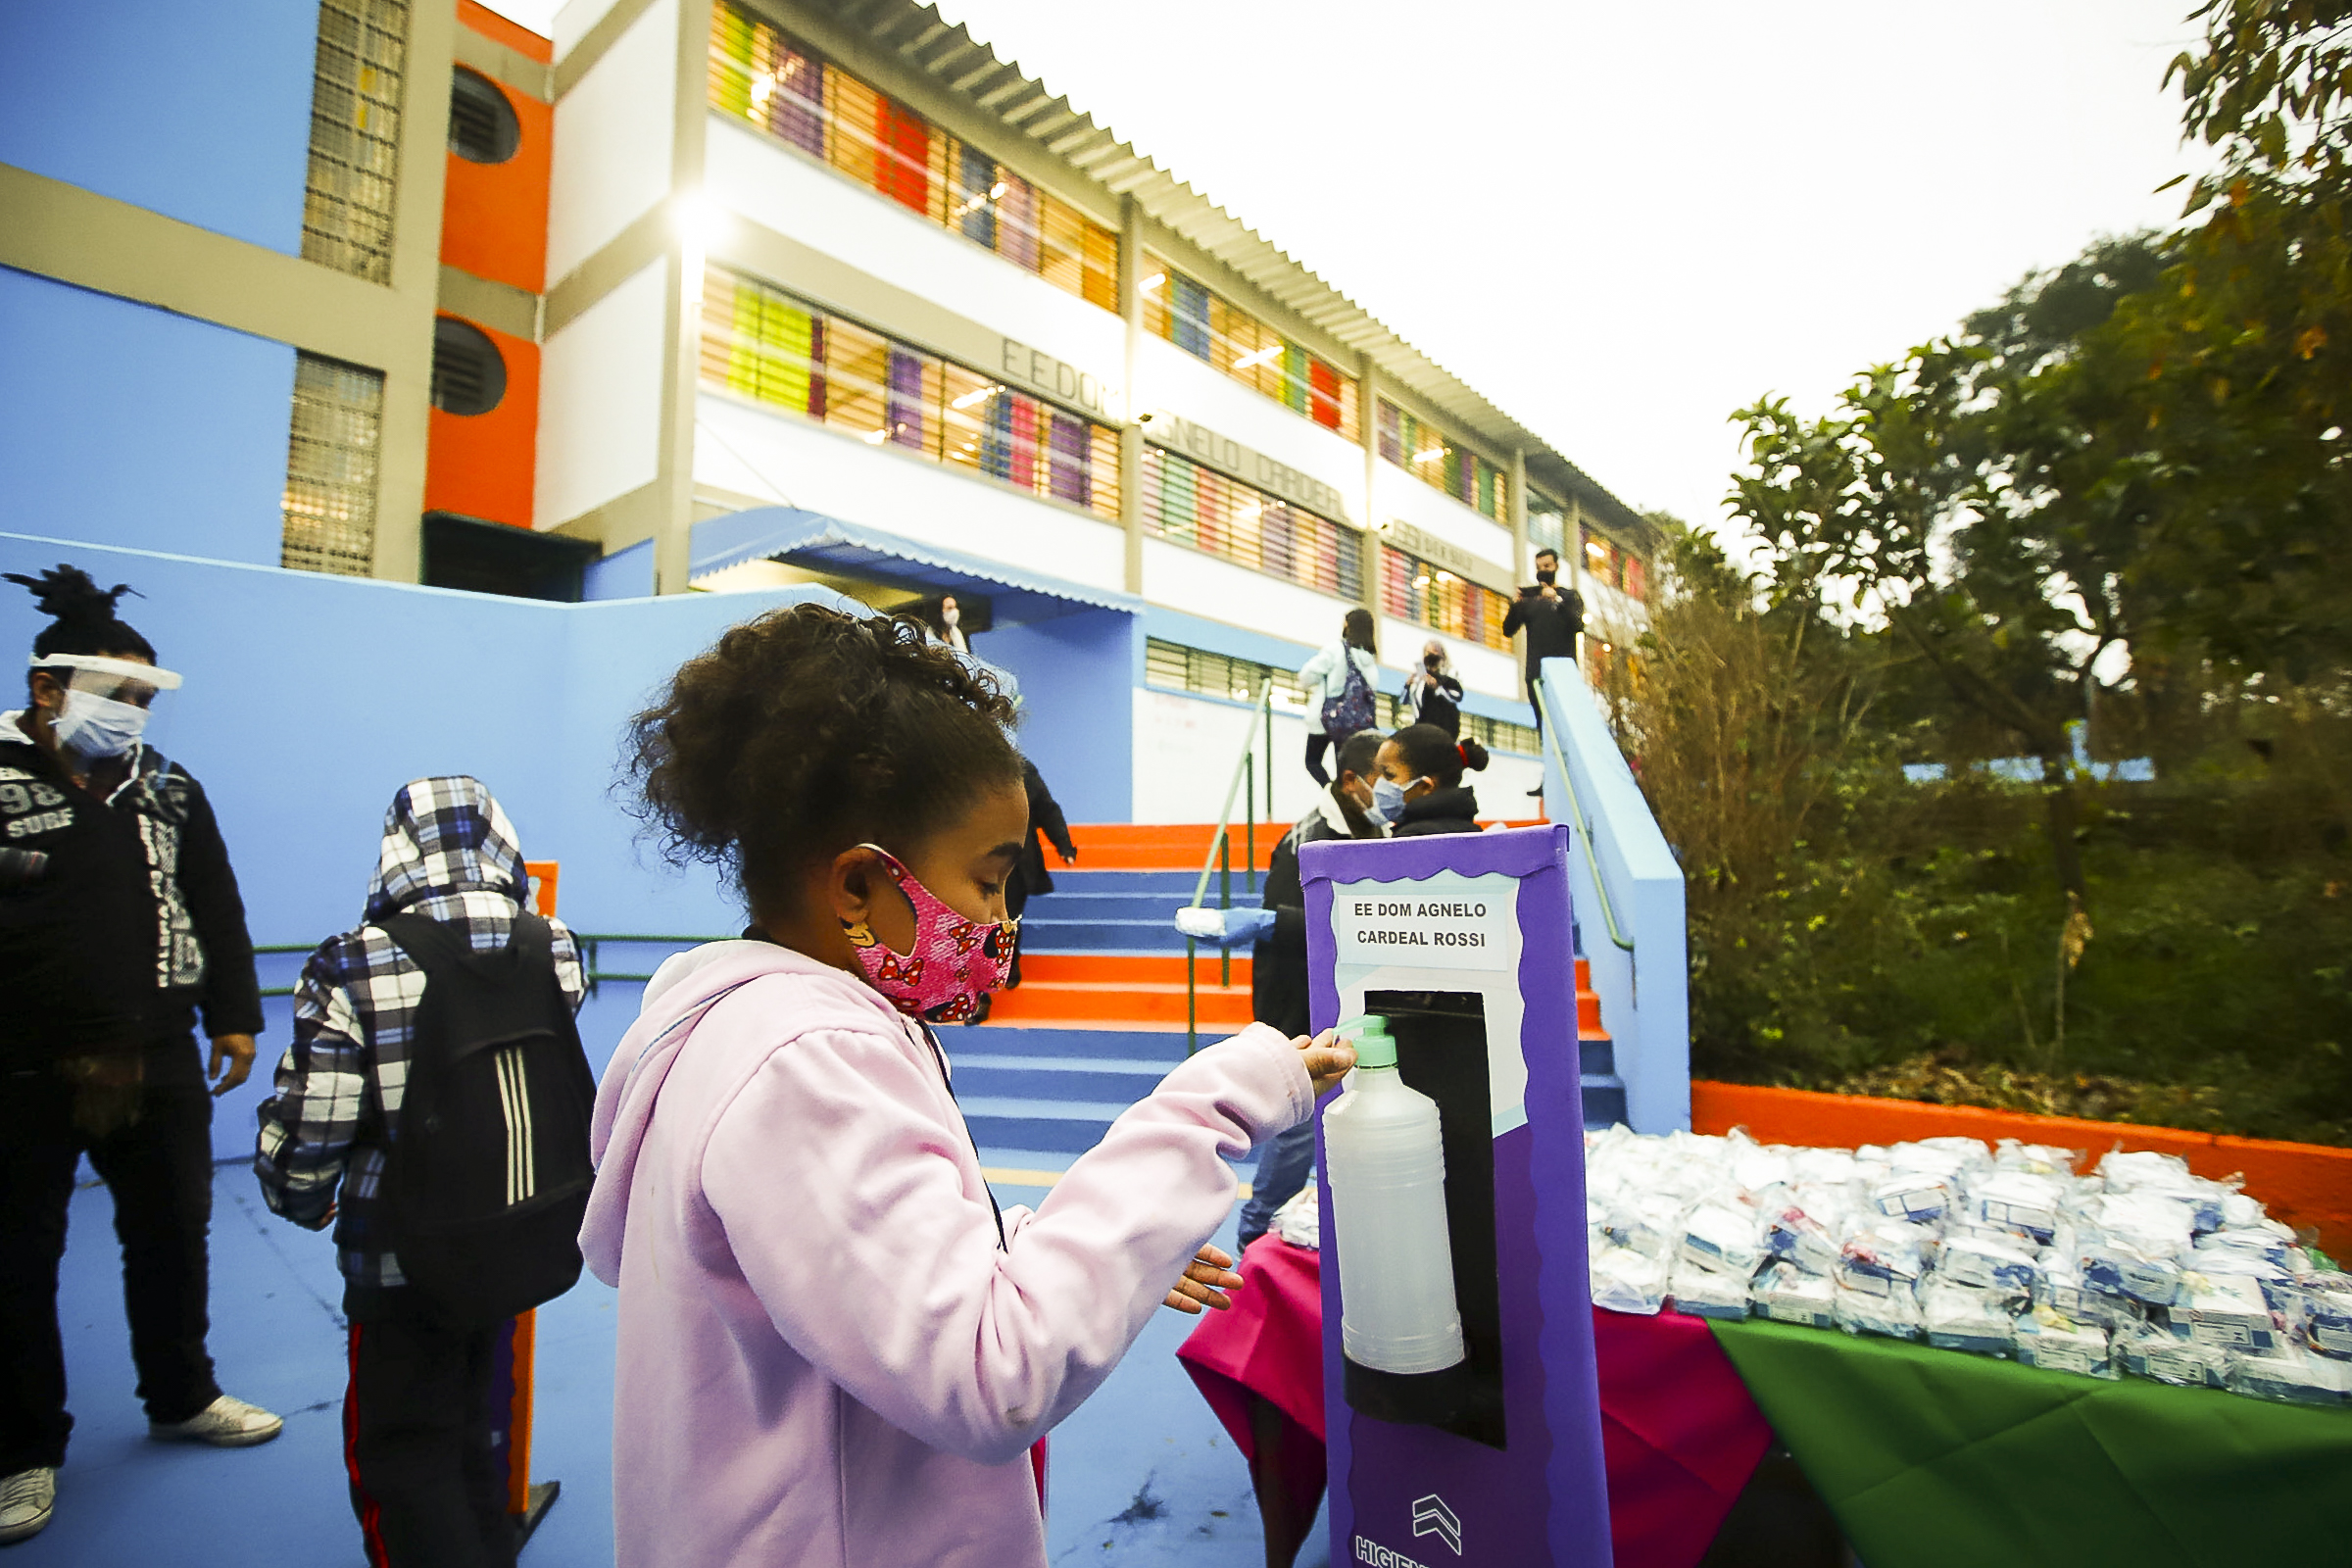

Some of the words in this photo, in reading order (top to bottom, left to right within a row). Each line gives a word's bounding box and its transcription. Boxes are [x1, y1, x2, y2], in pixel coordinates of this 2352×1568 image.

[1354, 903, 1373, 916] EE
[1378, 903, 1411, 917] DOM
[1417, 903, 1487, 917] AGNELO
[1357, 930, 1429, 946] CARDEAL
[1434, 932, 1486, 948] ROSSI
